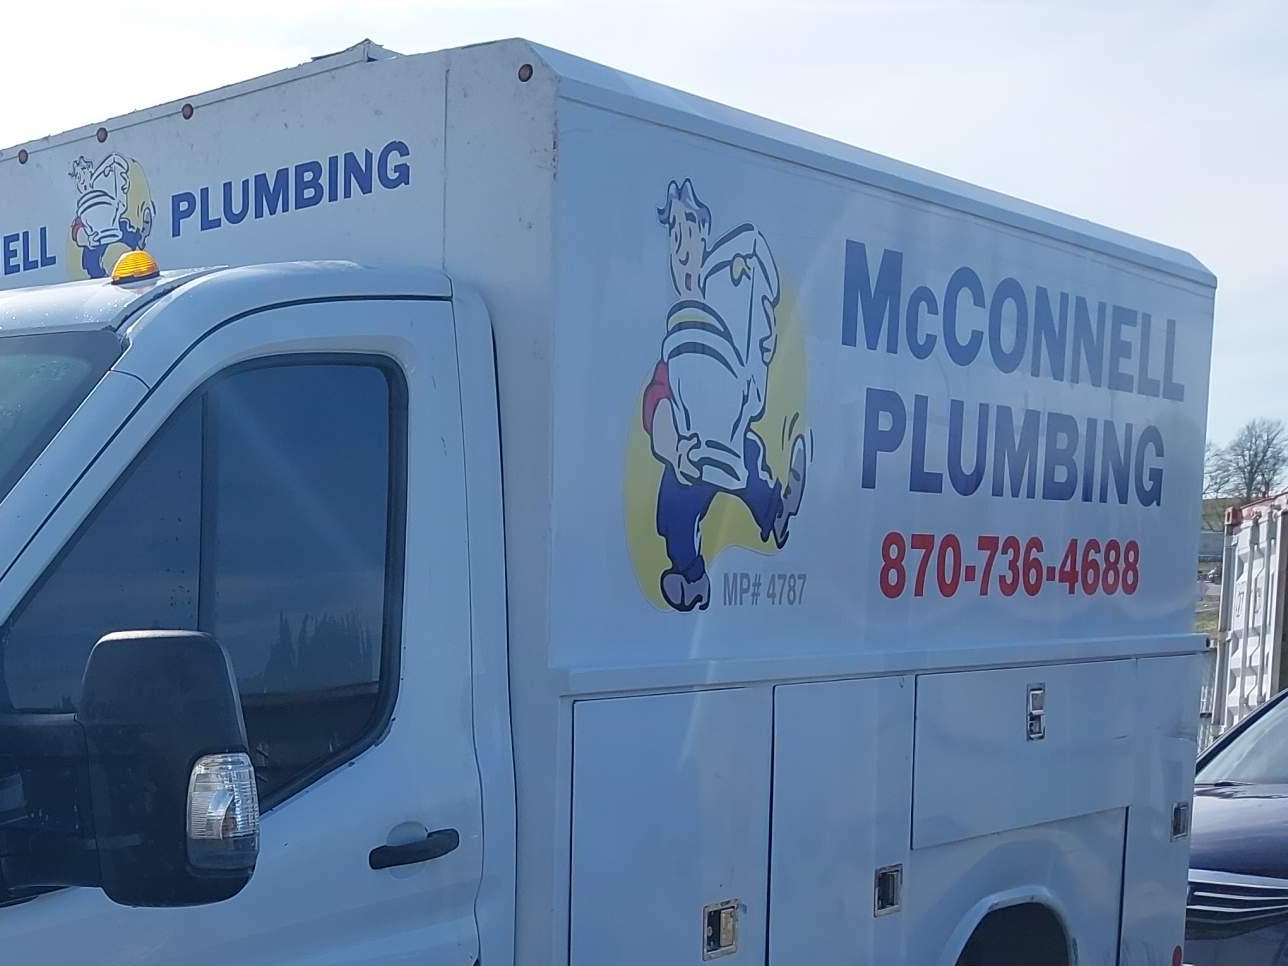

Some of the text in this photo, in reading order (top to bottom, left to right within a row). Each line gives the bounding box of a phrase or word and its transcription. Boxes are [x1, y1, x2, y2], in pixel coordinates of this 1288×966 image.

[171, 139, 412, 238] PLUMBING
[841, 239, 1186, 403] McCONNELL
[860, 387, 1166, 508] PLUMBING
[723, 572, 807, 606] MP# 4787
[879, 531, 1141, 599] 870-736-4688
